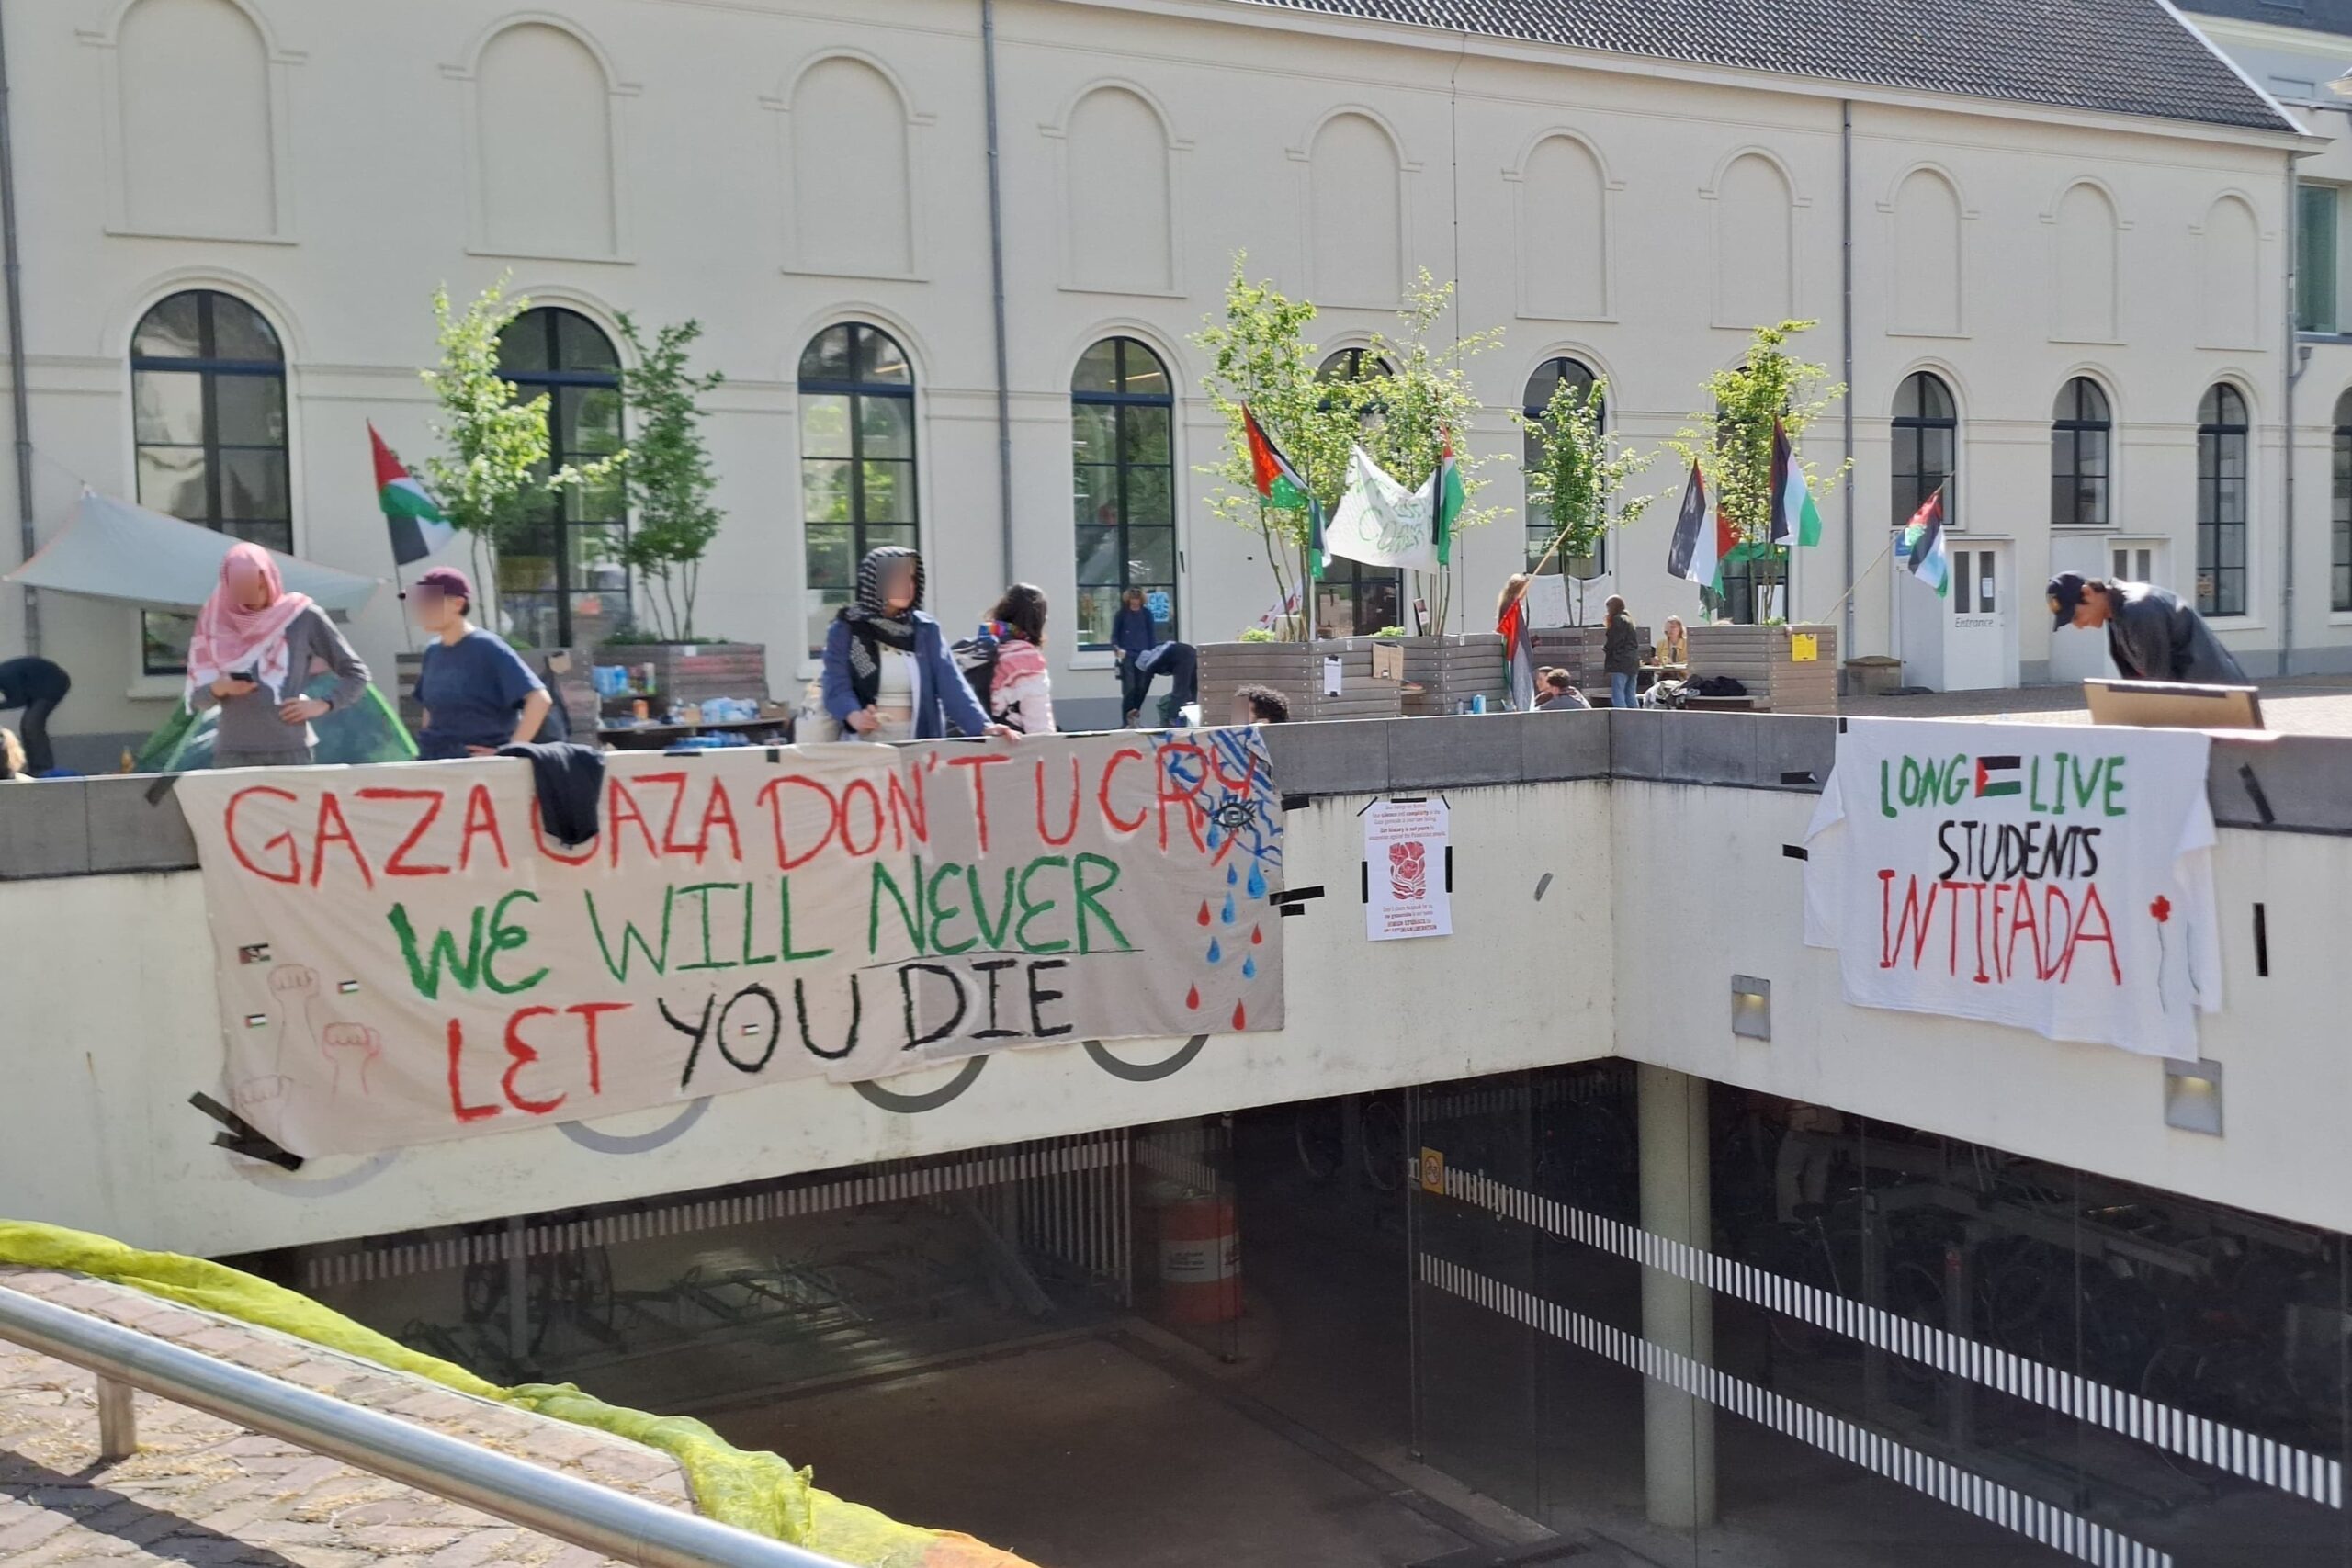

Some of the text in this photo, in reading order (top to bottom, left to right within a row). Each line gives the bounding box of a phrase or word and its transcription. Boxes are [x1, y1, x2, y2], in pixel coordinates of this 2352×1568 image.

[1954, 616, 1994, 628] Entrance
[225, 785, 508, 889] GAZA
[757, 751, 1010, 870] DON'T
[1035, 753, 1080, 846] U
[1880, 752, 2127, 818] LONG LIVE
[1938, 819, 2103, 882] STUDENTS
[387, 852, 1131, 1000] WE WILL NEVER
[1876, 868, 2122, 987] INTIFADA
[447, 958, 1074, 1122] LET YOU DIE
